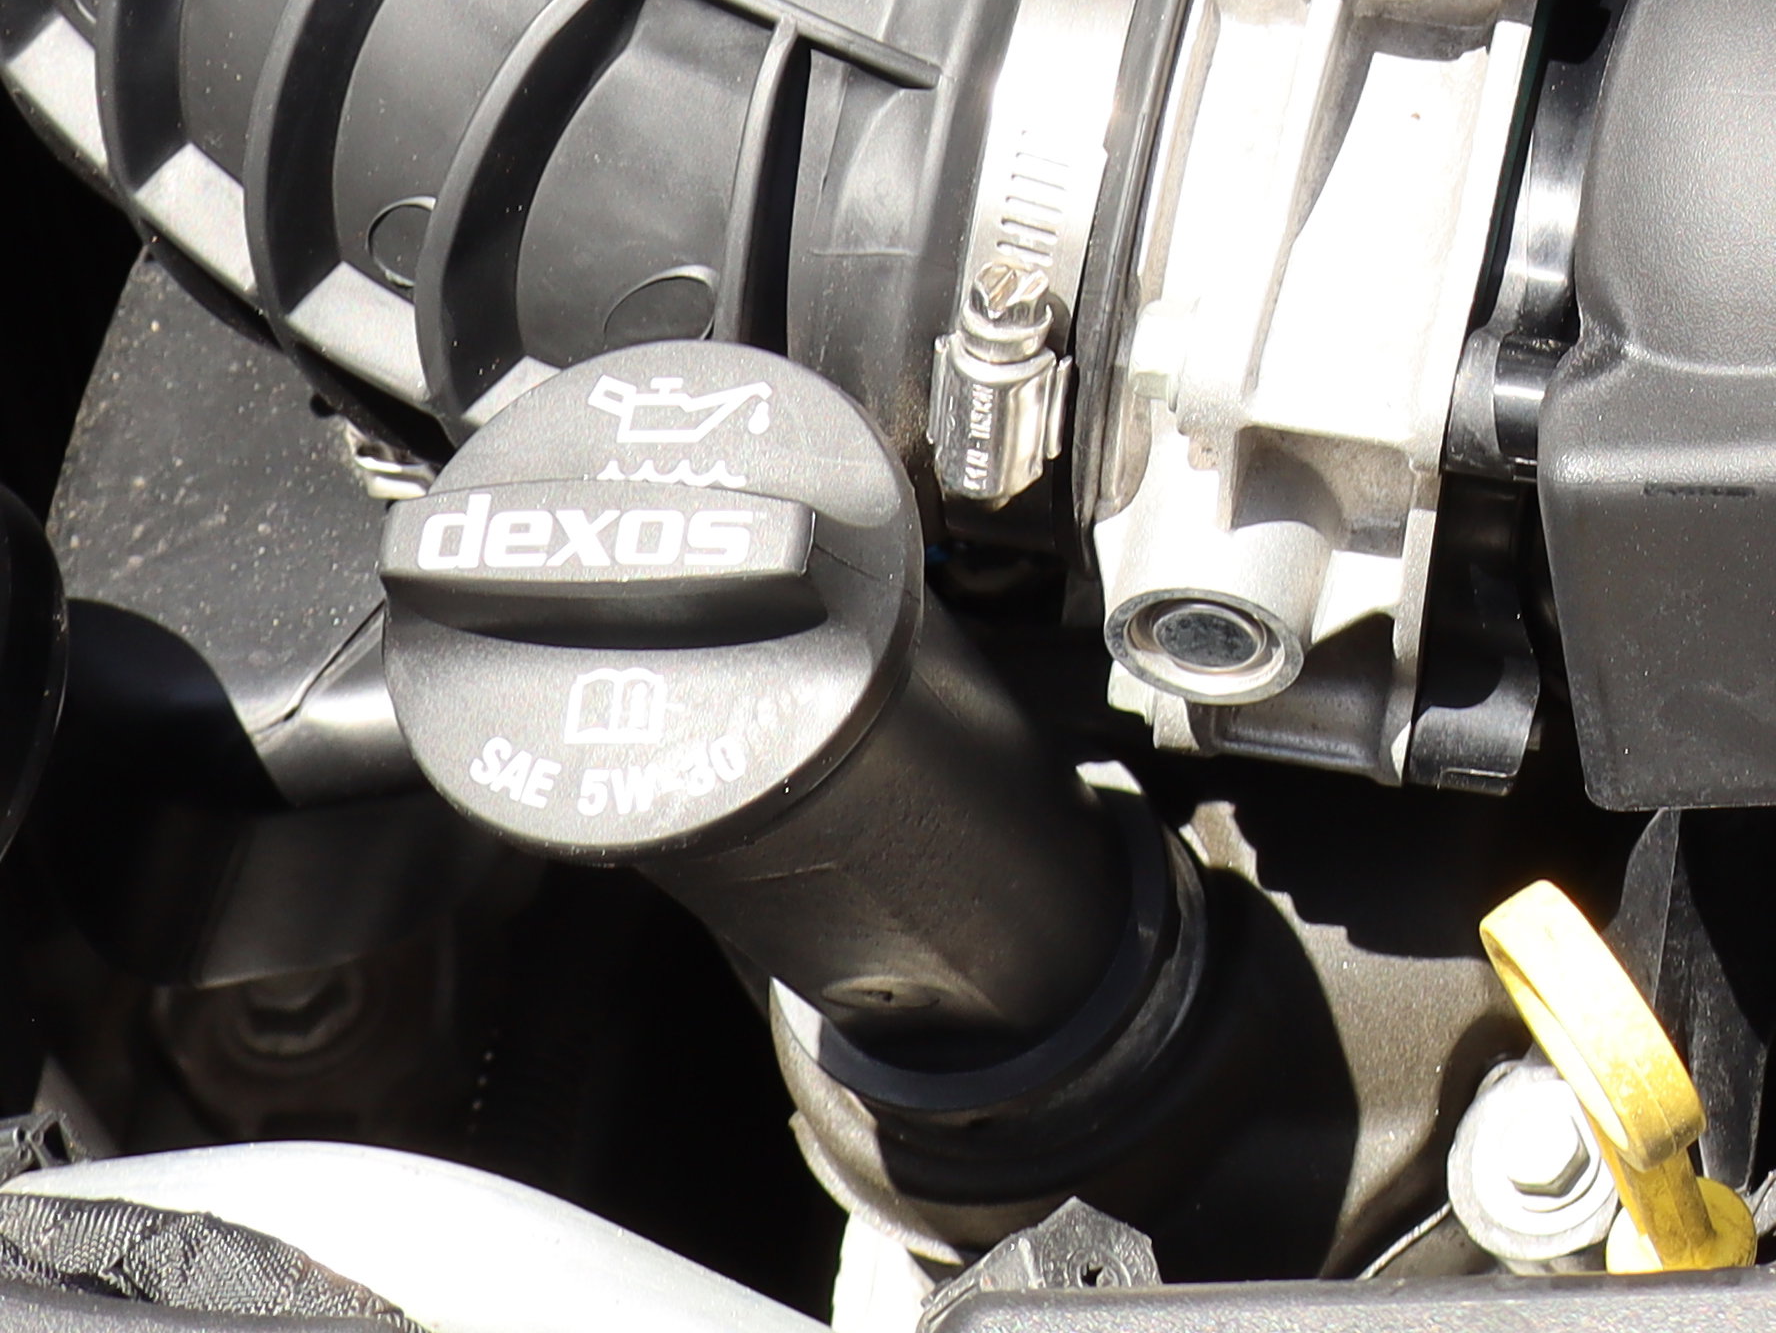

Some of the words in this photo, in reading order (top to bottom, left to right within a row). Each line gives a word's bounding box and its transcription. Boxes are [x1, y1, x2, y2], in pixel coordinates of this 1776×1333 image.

[416, 493, 755, 572] dexos
[470, 736, 563, 810] SAE
[577, 734, 748, 816] 5W-30
